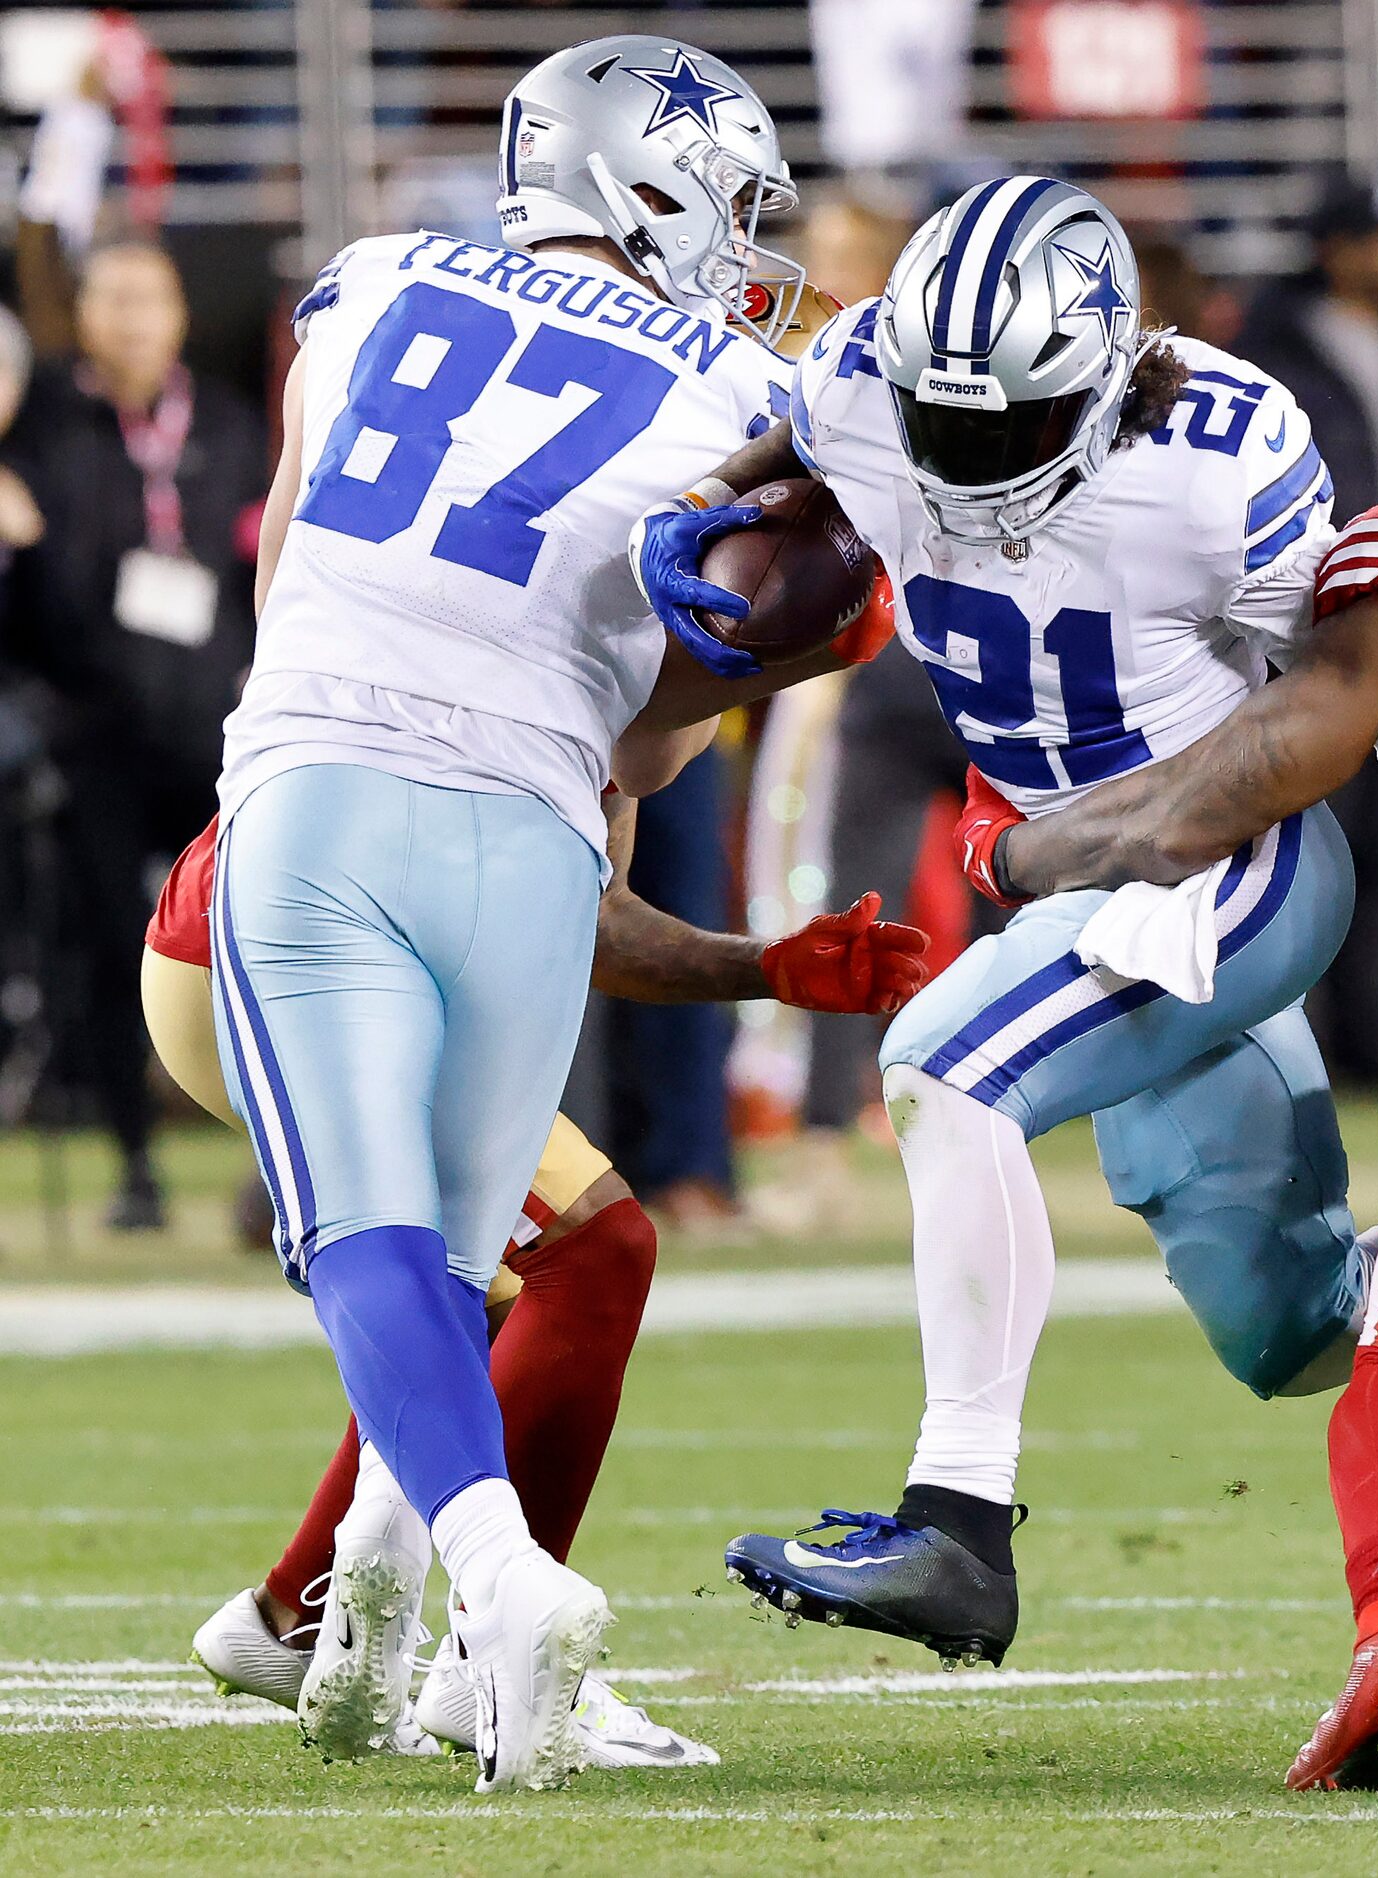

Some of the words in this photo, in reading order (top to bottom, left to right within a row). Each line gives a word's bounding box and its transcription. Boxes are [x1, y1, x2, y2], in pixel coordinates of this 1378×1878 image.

[398, 235, 739, 375] FERGUSON
[929, 379, 987, 396] COWBOYS
[292, 281, 679, 588] 87
[903, 573, 1154, 790] 21
